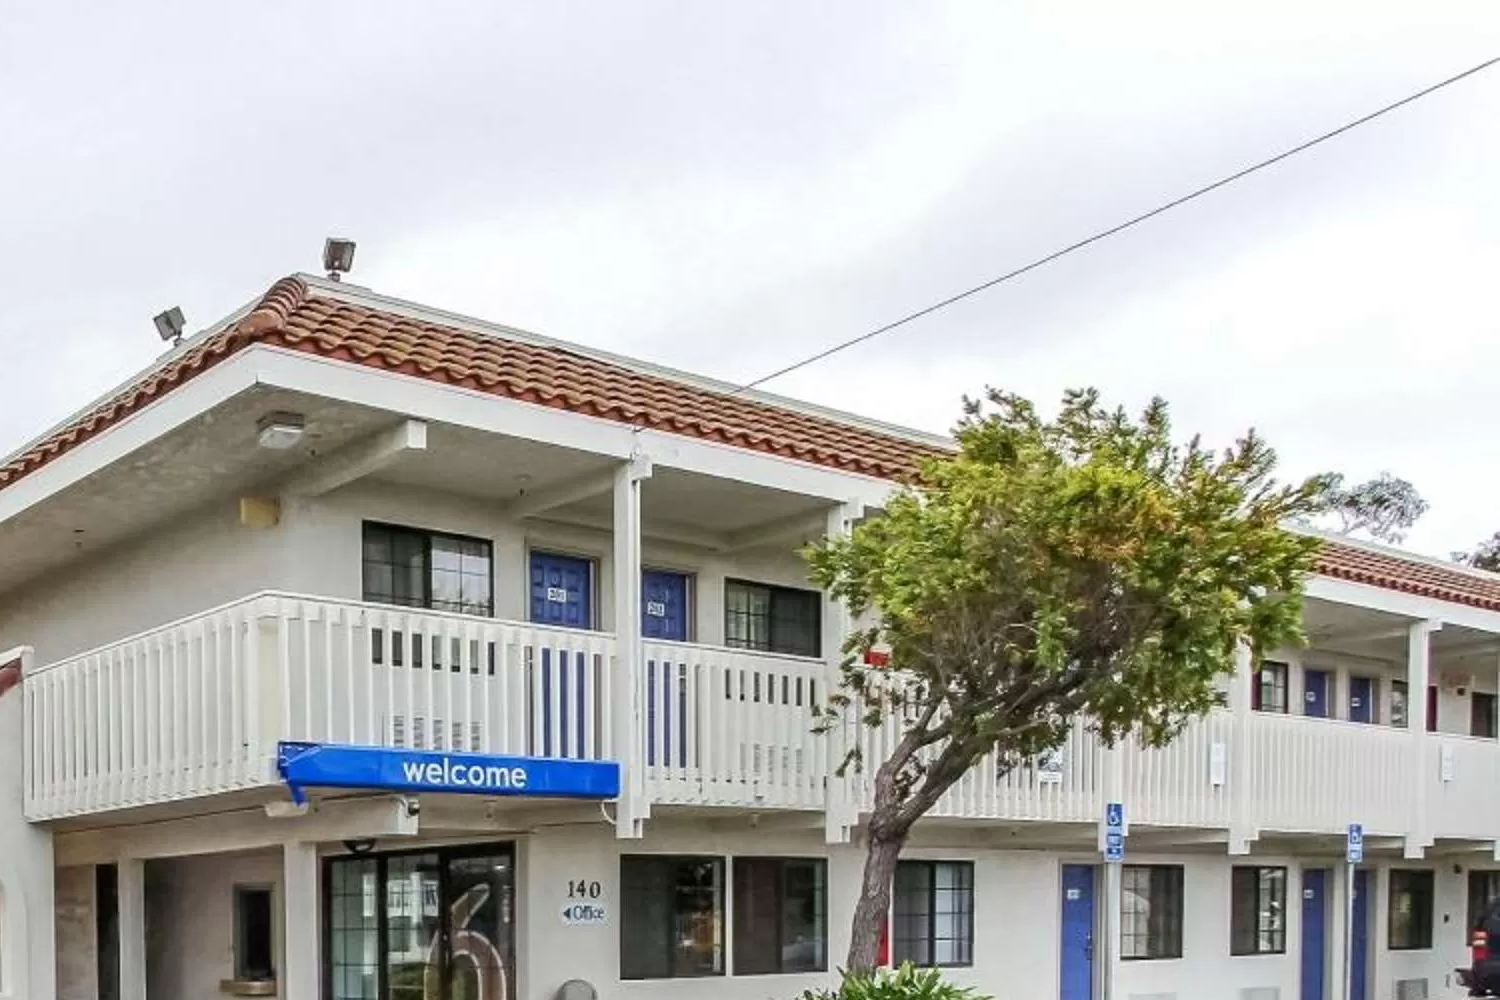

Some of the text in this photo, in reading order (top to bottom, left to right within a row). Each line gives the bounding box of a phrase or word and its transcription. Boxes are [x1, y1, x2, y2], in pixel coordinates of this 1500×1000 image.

[403, 757, 528, 788] welcome
[568, 879, 601, 899] 140
[573, 904, 605, 921] Office
